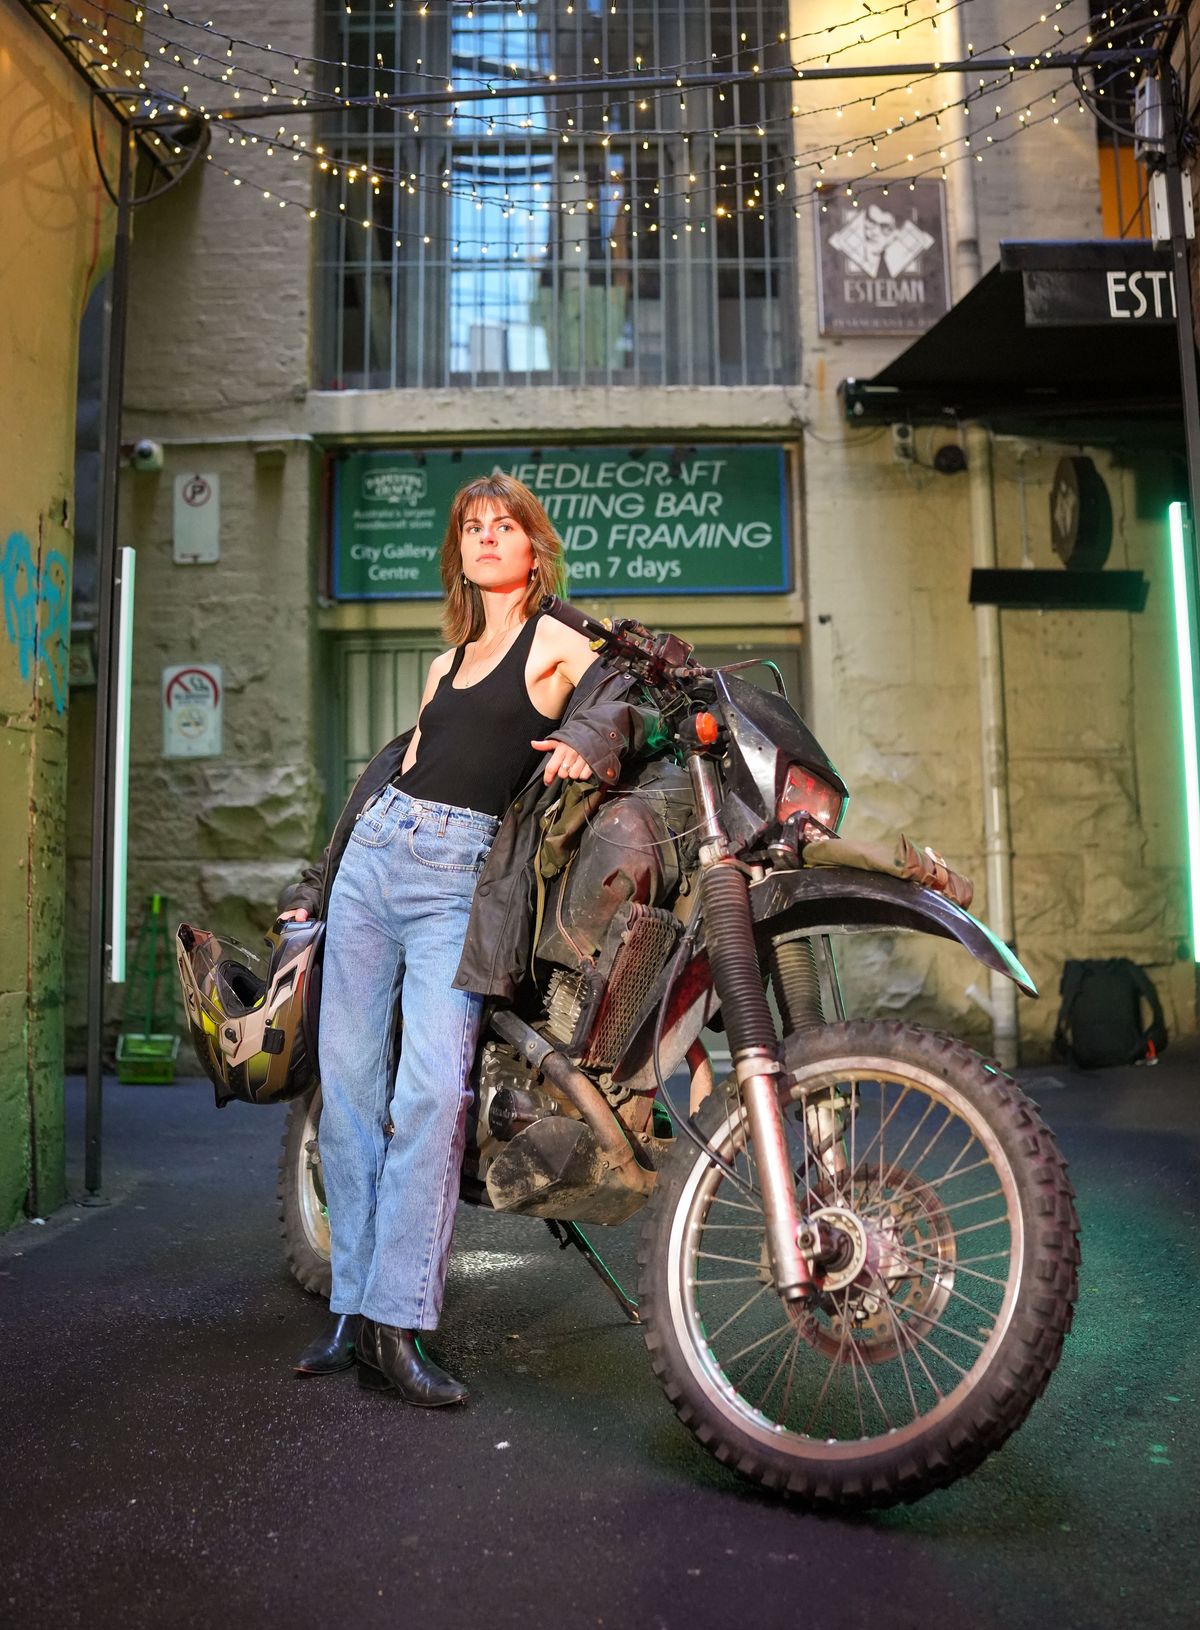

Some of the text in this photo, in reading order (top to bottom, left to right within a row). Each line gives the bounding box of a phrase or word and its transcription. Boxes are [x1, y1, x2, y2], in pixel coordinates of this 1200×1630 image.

[1106, 270, 1177, 319] EST
[538, 490, 724, 519] ITTING BAR
[551, 521, 773, 551] ND FRAMING
[383, 542, 438, 562] Gallery
[367, 564, 420, 581] Centre
[607, 556, 622, 579] 7
[626, 554, 682, 584] days
